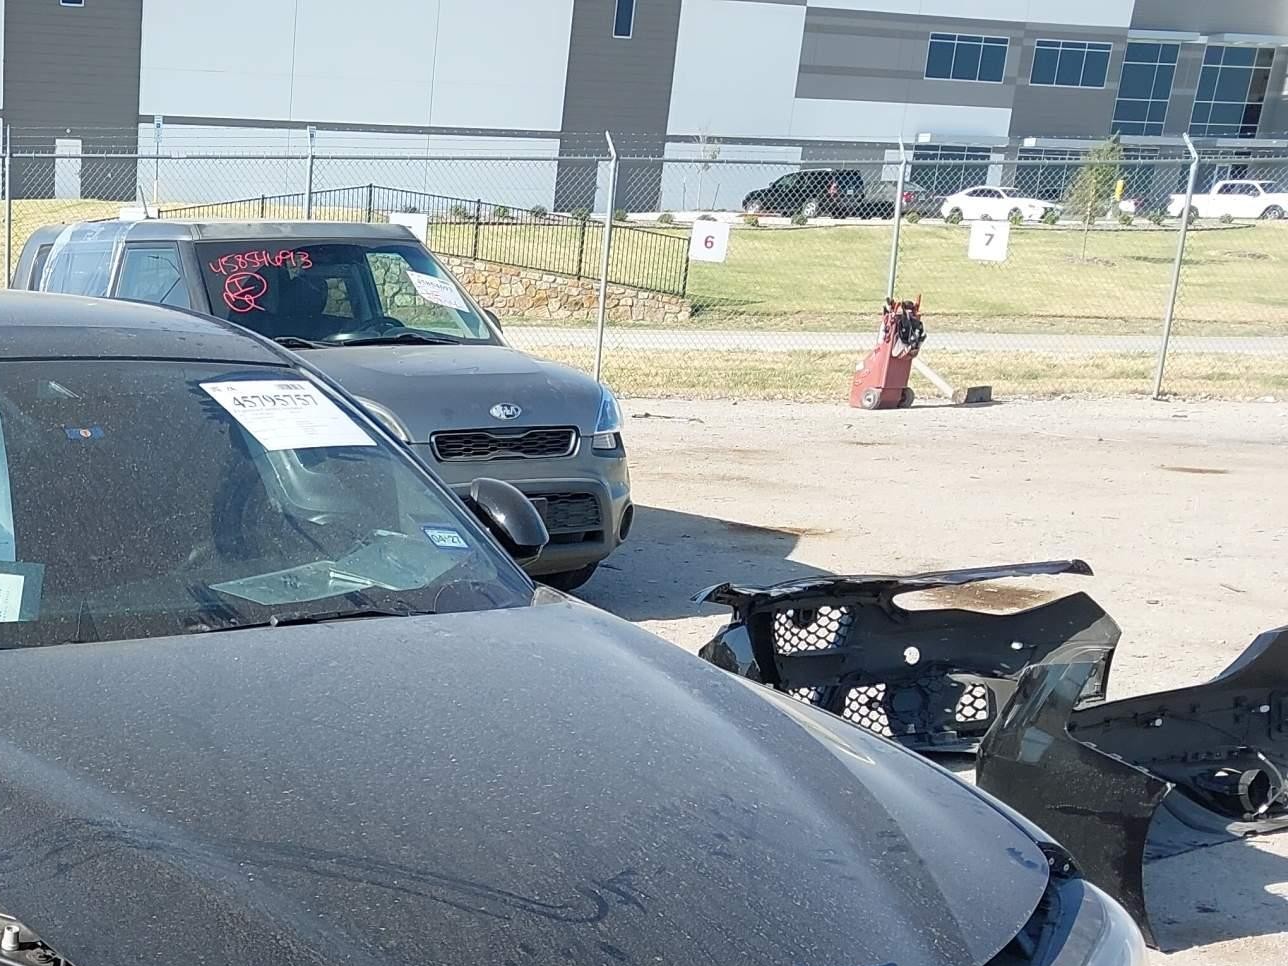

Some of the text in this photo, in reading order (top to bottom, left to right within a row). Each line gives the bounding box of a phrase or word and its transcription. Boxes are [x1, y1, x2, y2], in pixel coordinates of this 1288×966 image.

[704, 235, 715, 249] 6
[984, 233, 995, 246] 7
[232, 393, 319, 409] 45795757
